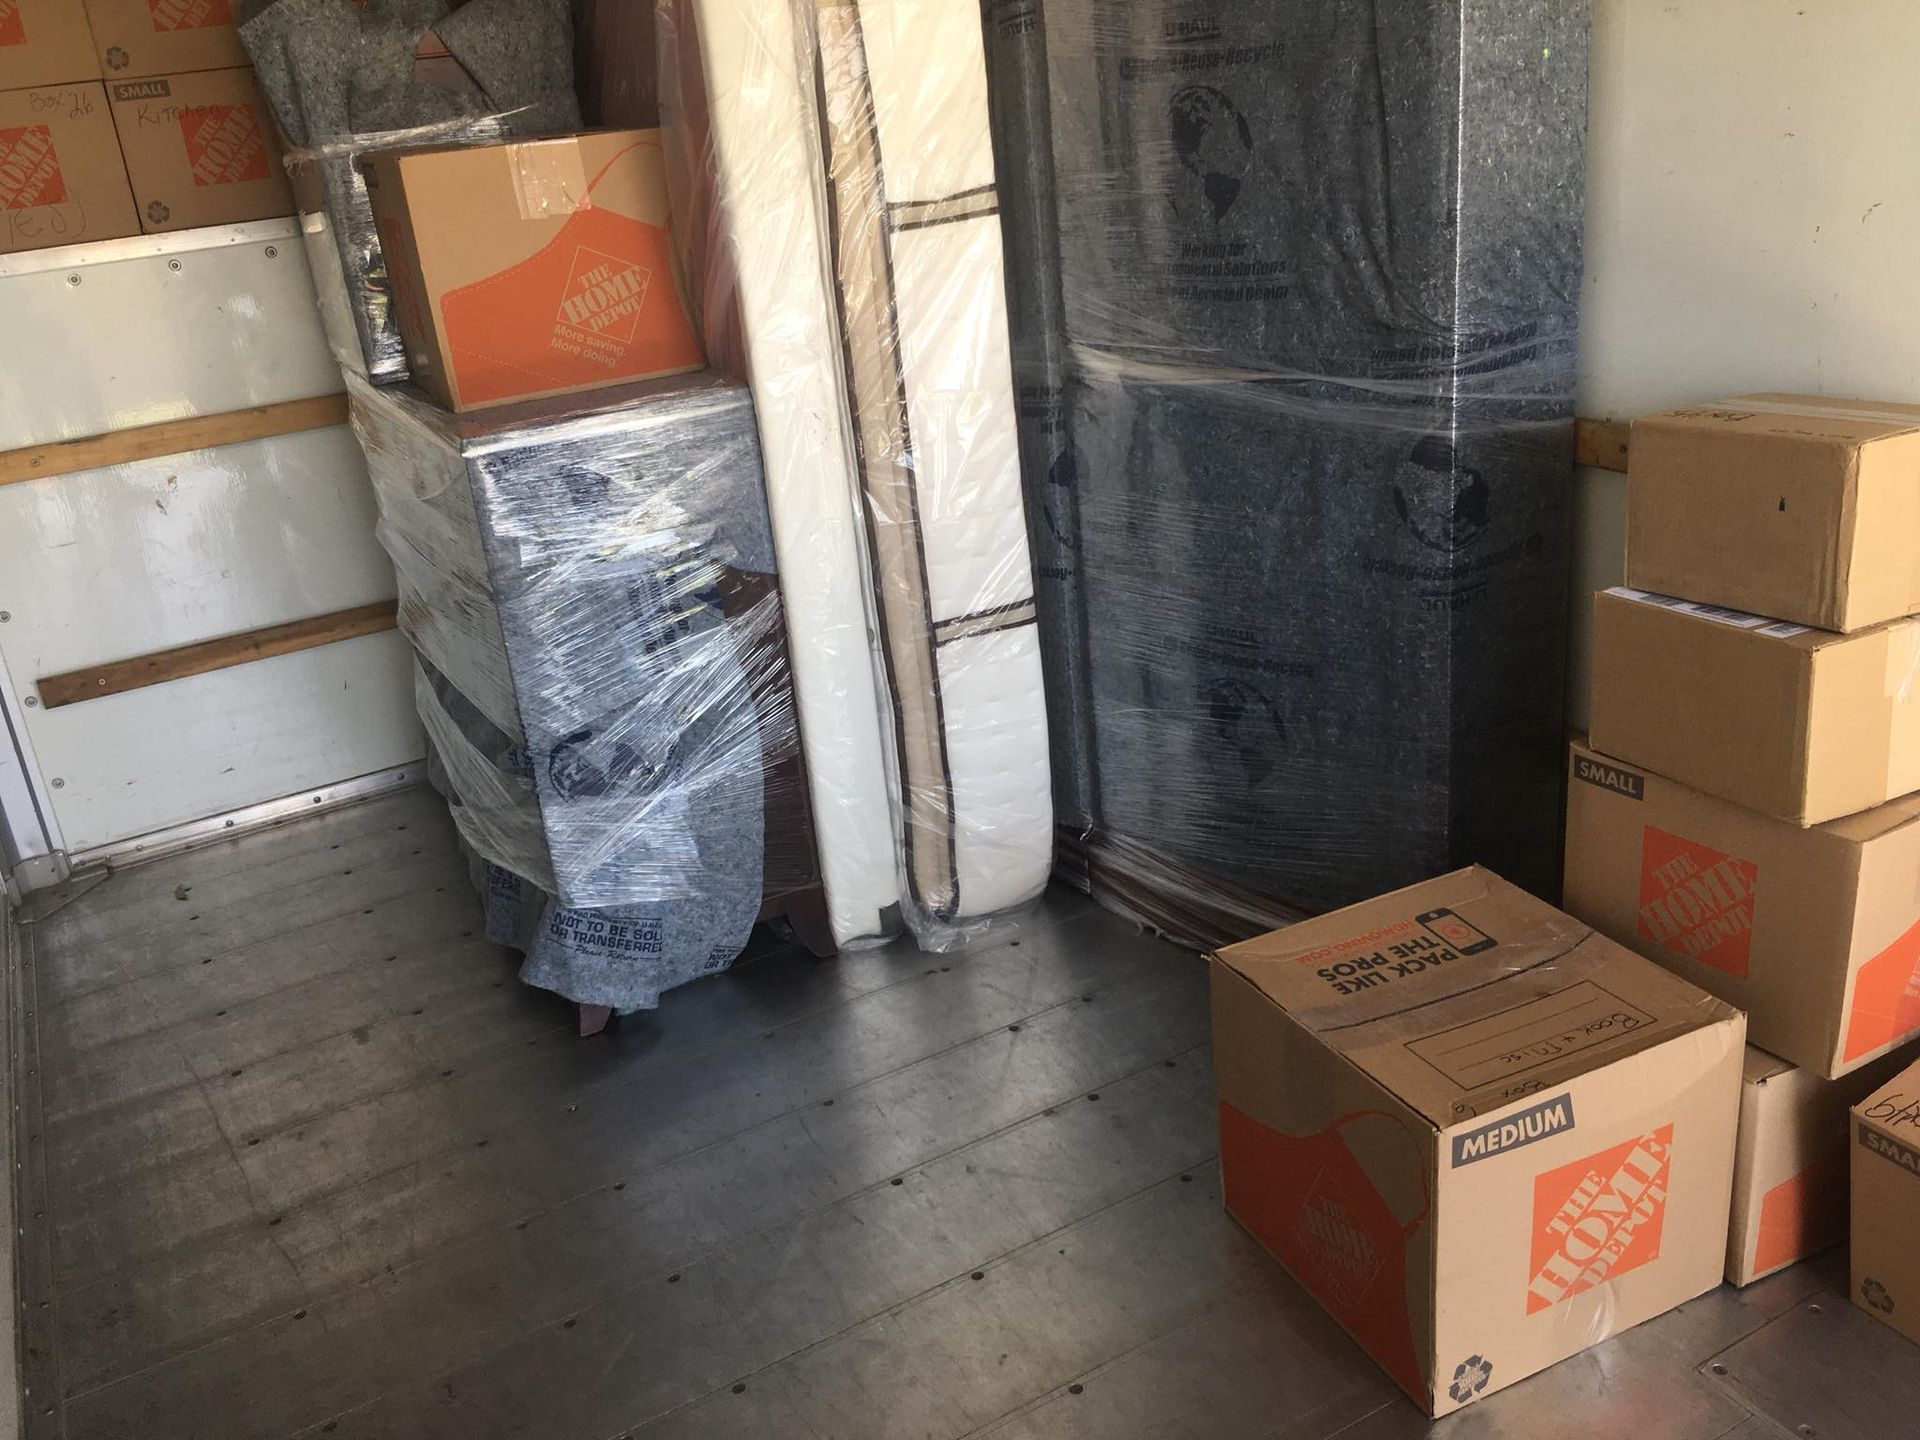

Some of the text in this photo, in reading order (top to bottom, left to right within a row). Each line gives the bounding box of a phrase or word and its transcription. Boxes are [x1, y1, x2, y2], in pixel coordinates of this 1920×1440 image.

[120, 84, 166, 98] SMALL
[192, 106, 256, 184] HOME
[193, 114, 219, 145] THE
[224, 134, 263, 181] DEPOT
[20, 154, 58, 207] DEPOT
[561, 265, 648, 325] HOME
[577, 263, 611, 289] THE
[591, 296, 640, 331] DEPOT
[551, 337, 618, 369] More doing.
[554, 323, 627, 356] More saving.
[1580, 761, 1637, 794] SMALL
[1651, 850, 1698, 889] THE
[1639, 856, 1756, 942] HOME
[550, 924, 569, 939] OR
[554, 912, 663, 942] NOT TO BE SOL
[1680, 903, 1750, 956] DEPOT
[1316, 935, 1441, 982] THE PROS
[1332, 948, 1459, 995] PACK LIKE
[1502, 1080, 1549, 1098] Box
[1461, 1103, 1568, 1160] MEDIUM
[1866, 1132, 1920, 1173] SMA
[1529, 1131, 1671, 1304] HOME
[1545, 1169, 1607, 1235] THE
[1580, 1178, 1668, 1287] DEPOT
